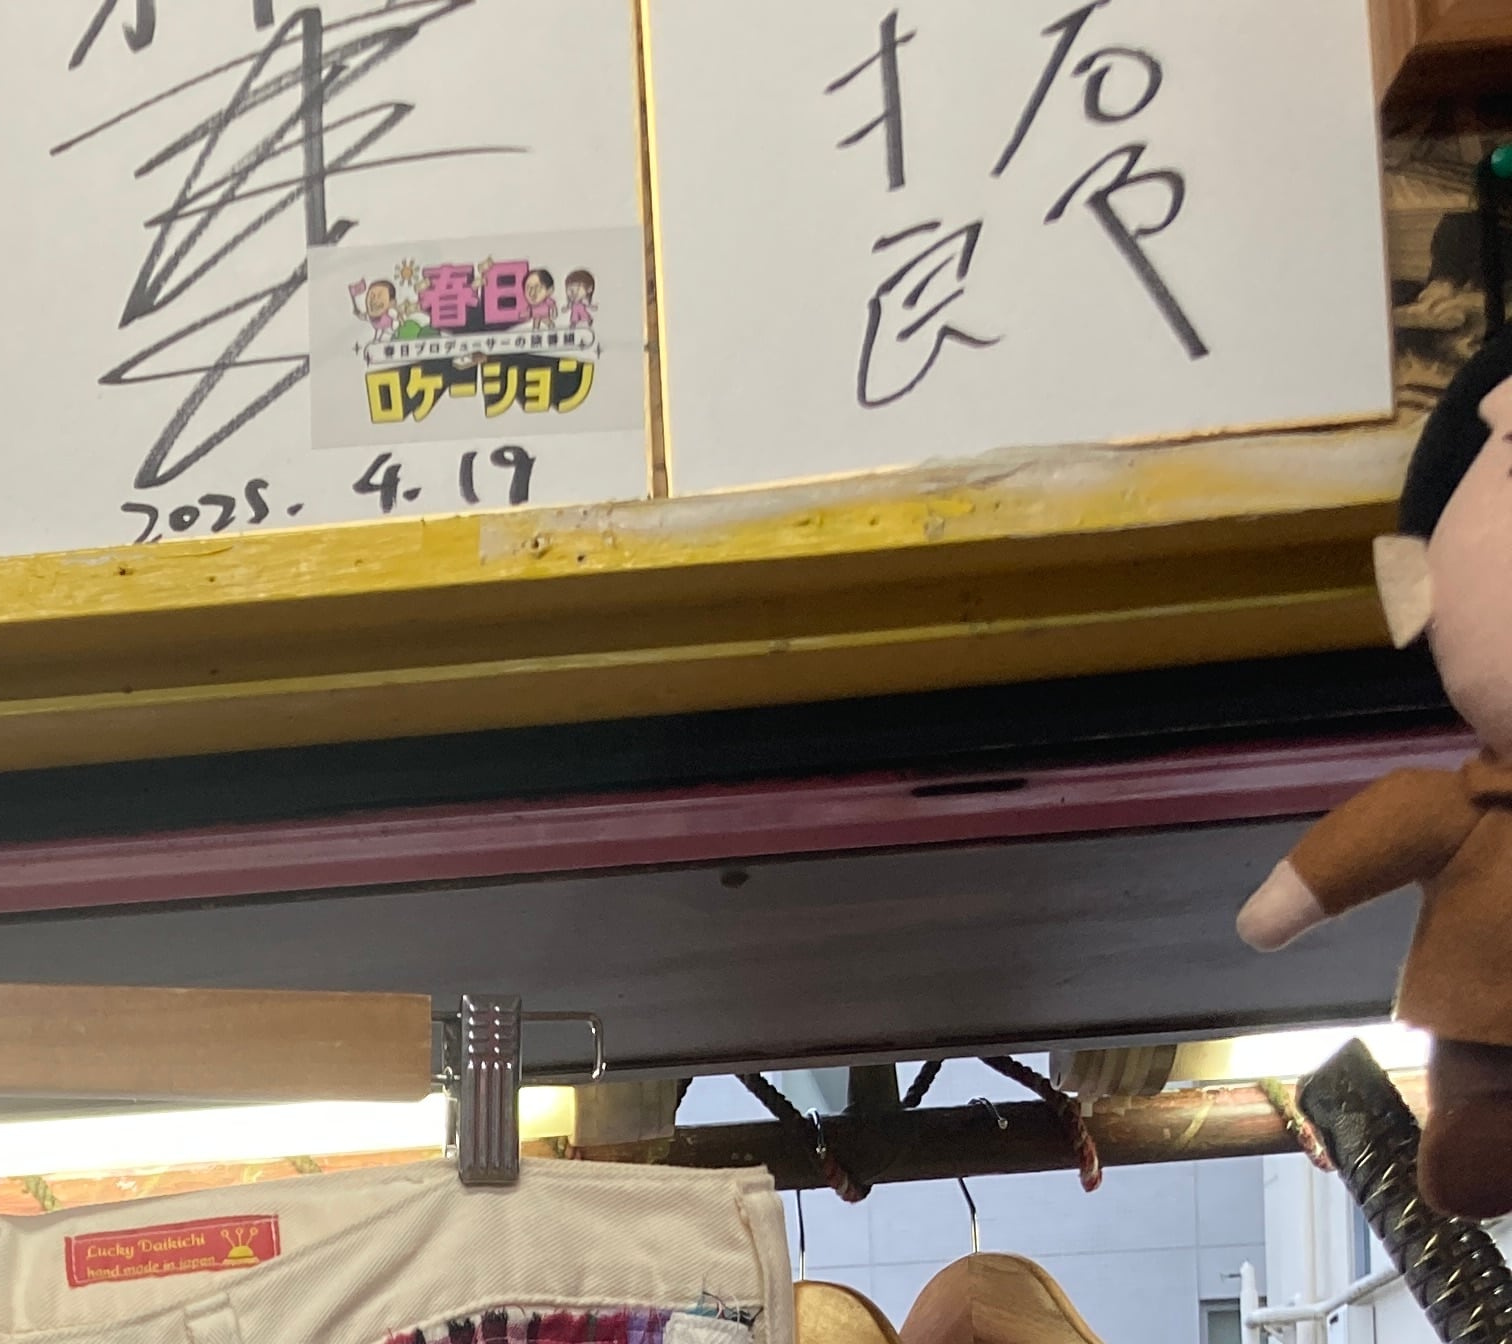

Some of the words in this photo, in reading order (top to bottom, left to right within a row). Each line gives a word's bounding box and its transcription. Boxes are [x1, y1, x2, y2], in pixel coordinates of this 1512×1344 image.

[418, 259, 531, 333] 春日
[364, 356, 595, 425] ロケーション
[86, 1243, 135, 1259] Lucky
[139, 1233, 205, 1252] Daikichi
[162, 1260, 176, 1271] in
[178, 1254, 216, 1272] japan
